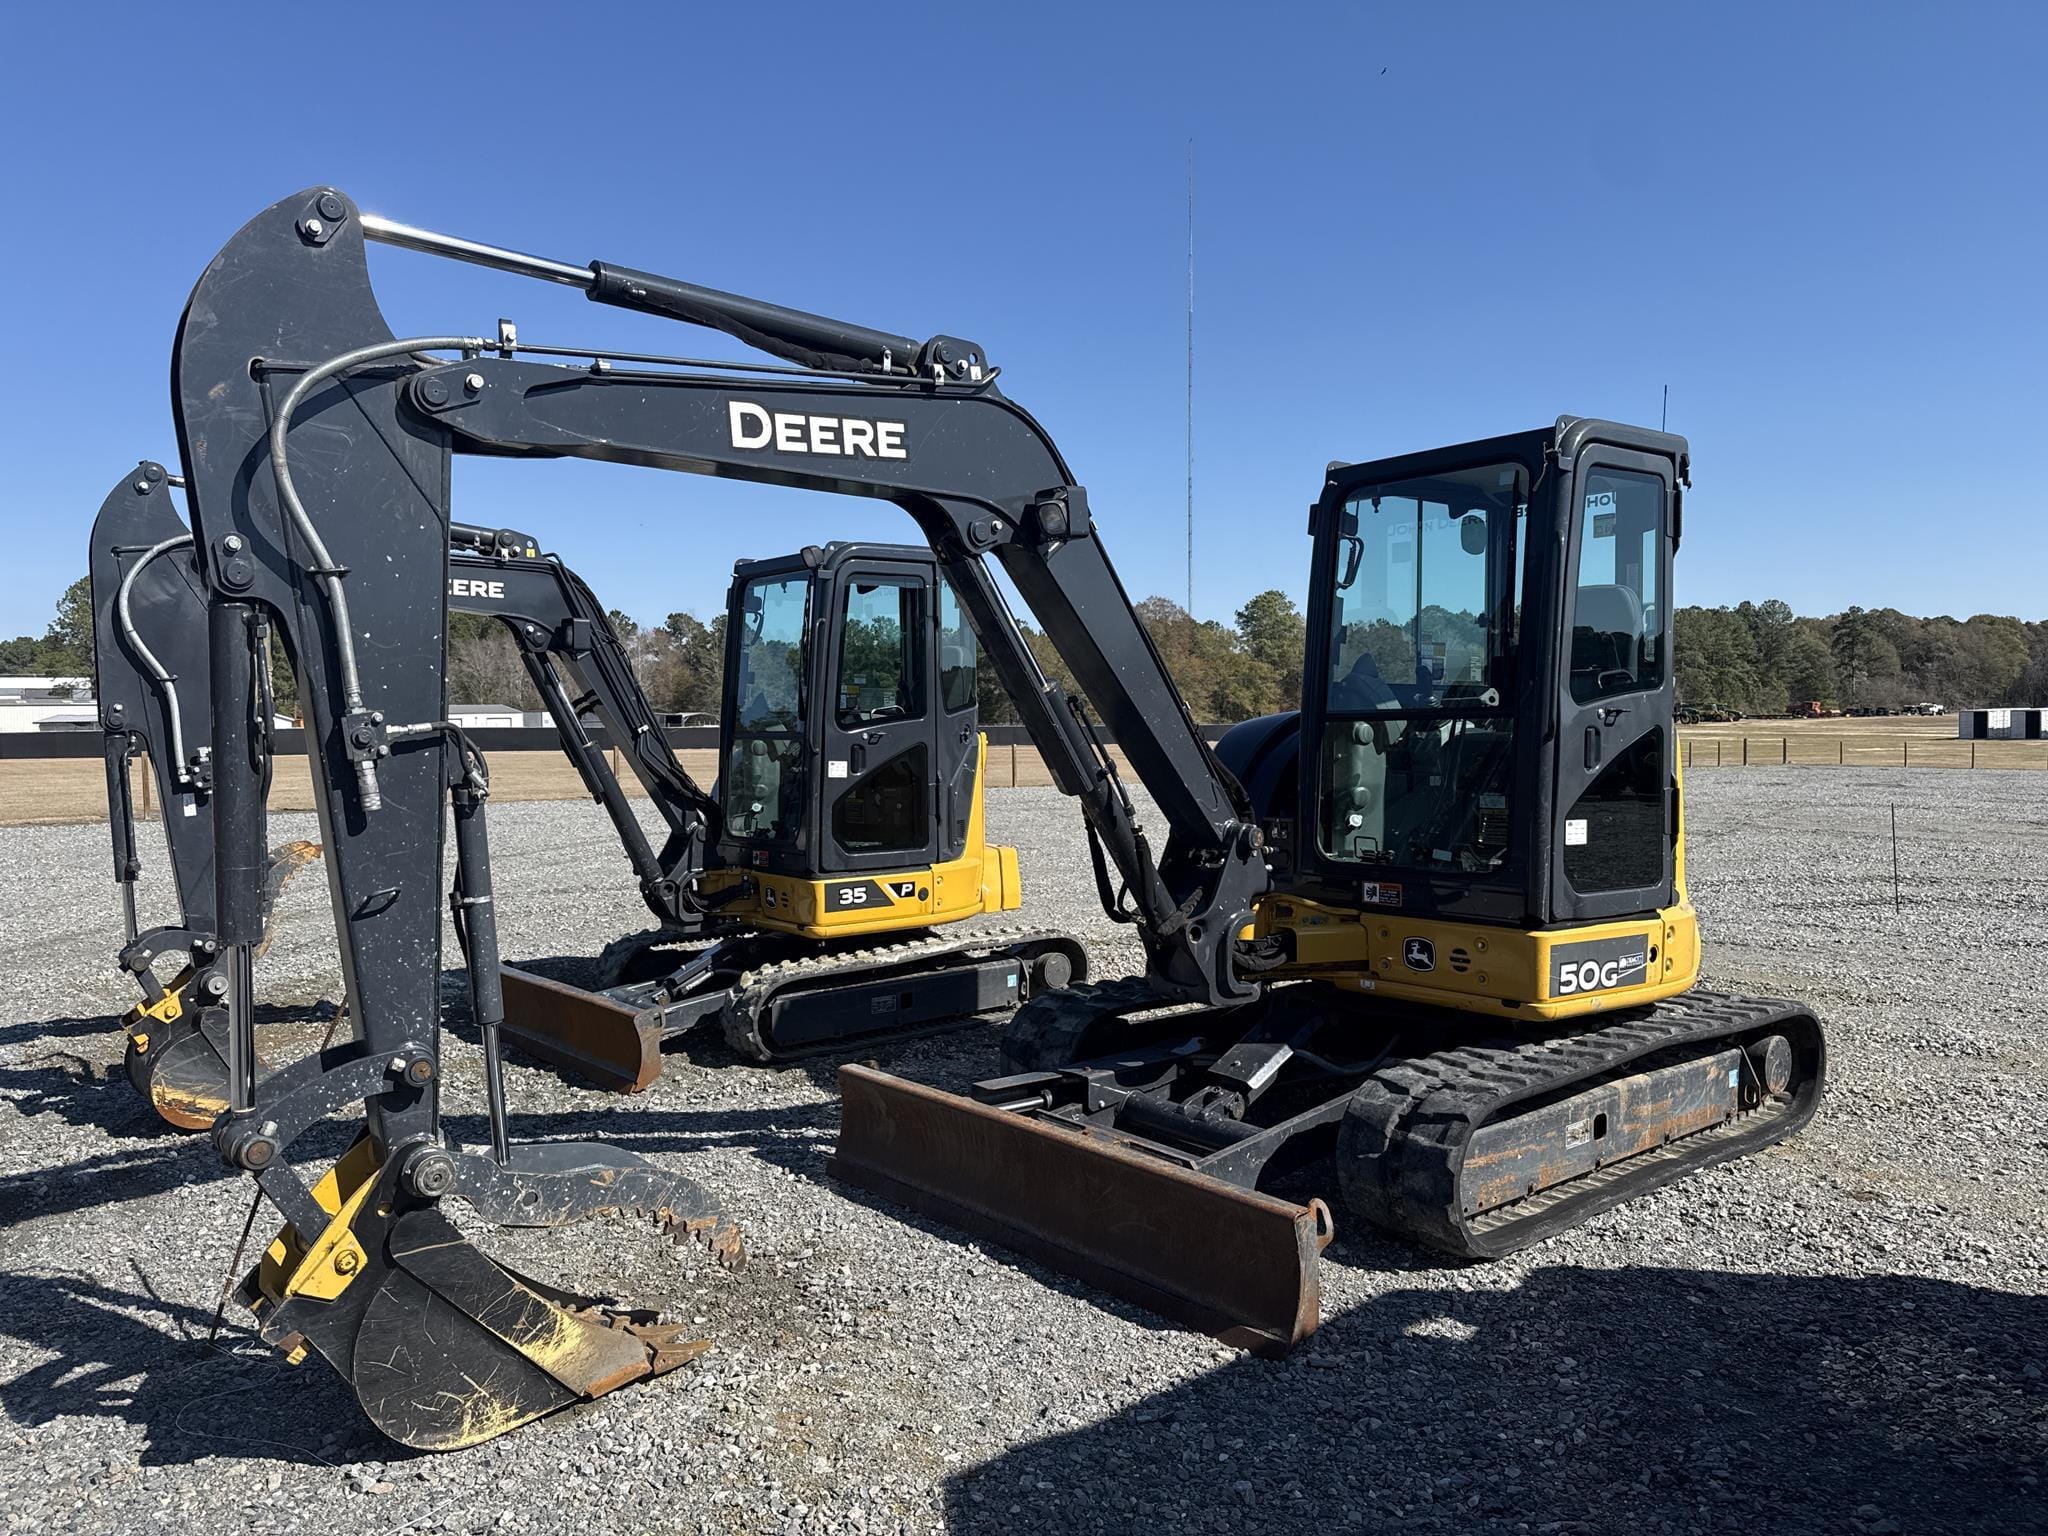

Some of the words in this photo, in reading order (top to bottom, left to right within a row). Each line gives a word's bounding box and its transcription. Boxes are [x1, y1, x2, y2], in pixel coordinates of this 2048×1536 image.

[729, 400, 906, 458] DEERE
[1387, 519, 1433, 537] JOHN
[449, 578, 505, 599] ERE
[839, 887, 867, 905] 35
[901, 883, 913, 897] P
[1559, 960, 1618, 994] 50G
